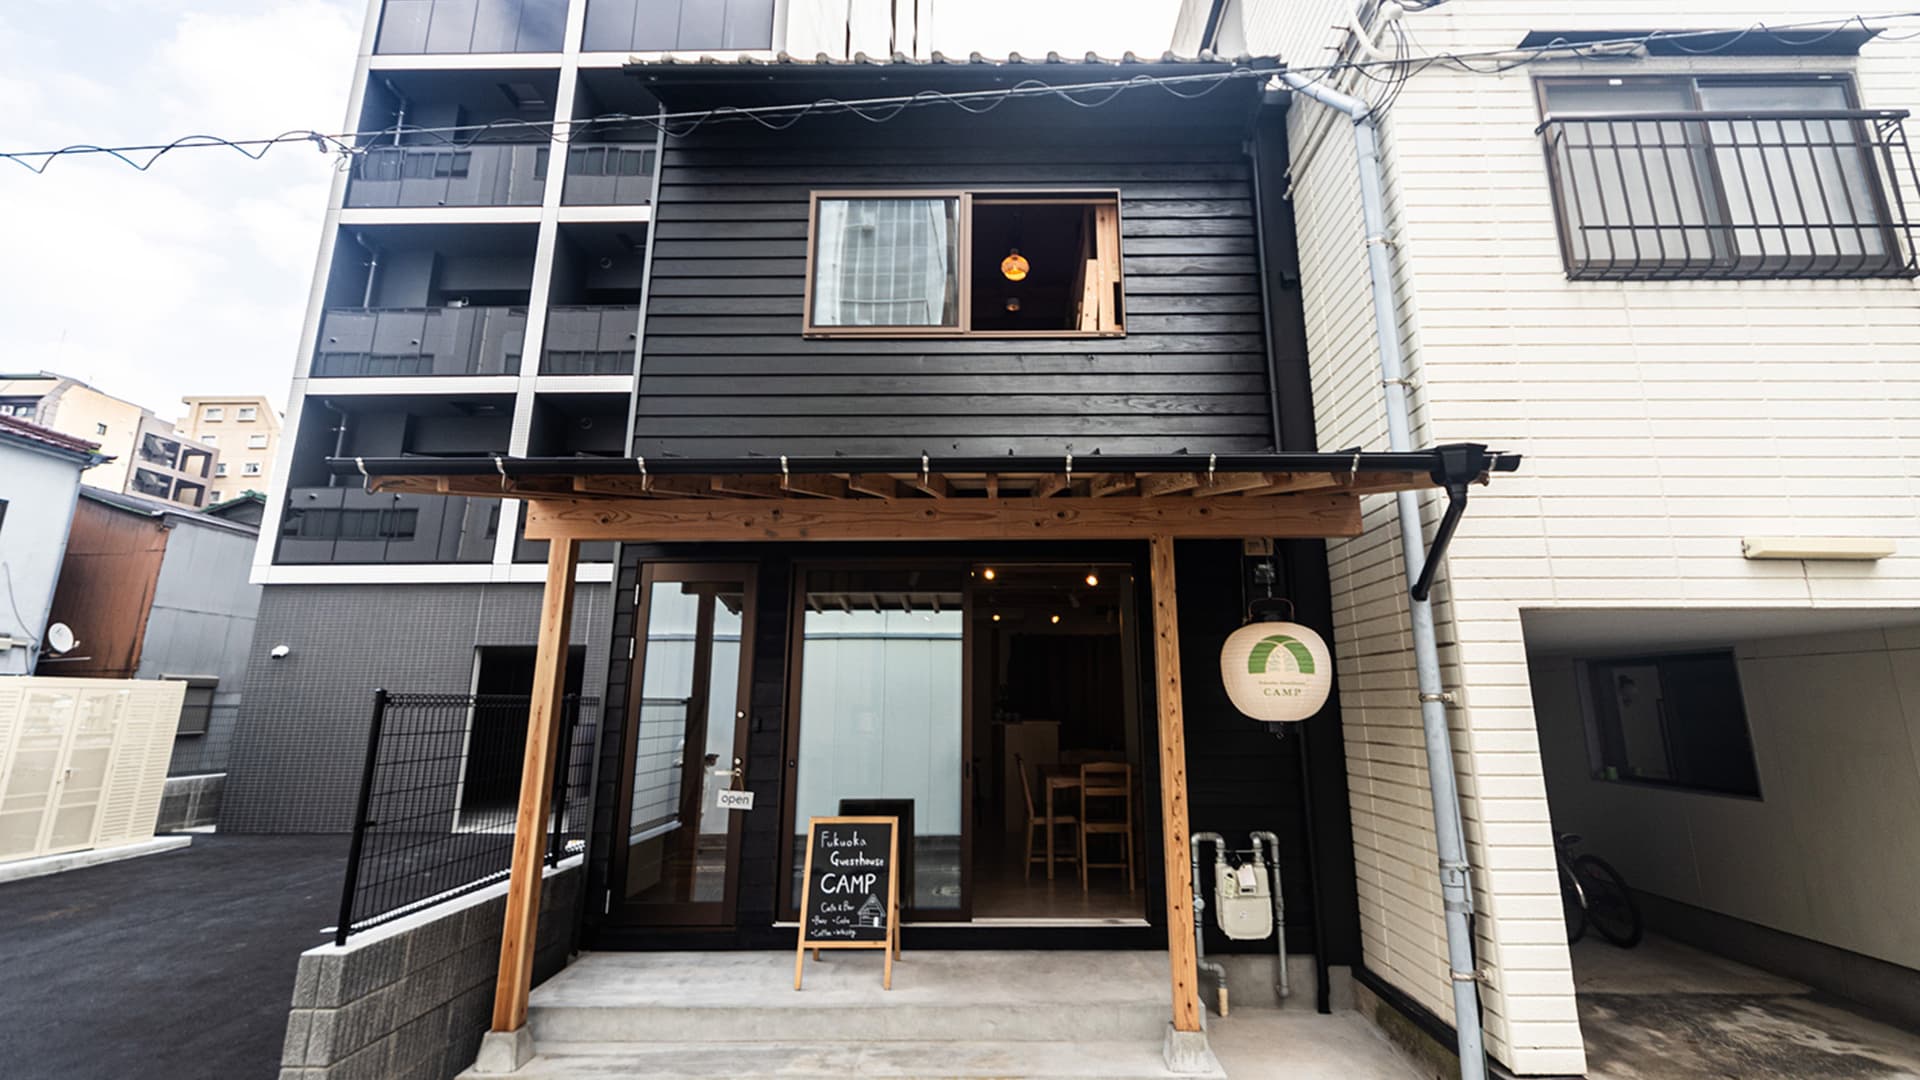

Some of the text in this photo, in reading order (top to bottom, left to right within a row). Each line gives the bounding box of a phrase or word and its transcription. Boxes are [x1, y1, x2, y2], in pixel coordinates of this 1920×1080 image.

[1263, 687, 1301, 697] CAMP
[721, 794, 750, 806] open
[821, 830, 867, 848] Fukuoka
[830, 850, 884, 867] Guesthouse
[820, 873, 877, 894] CAMP
